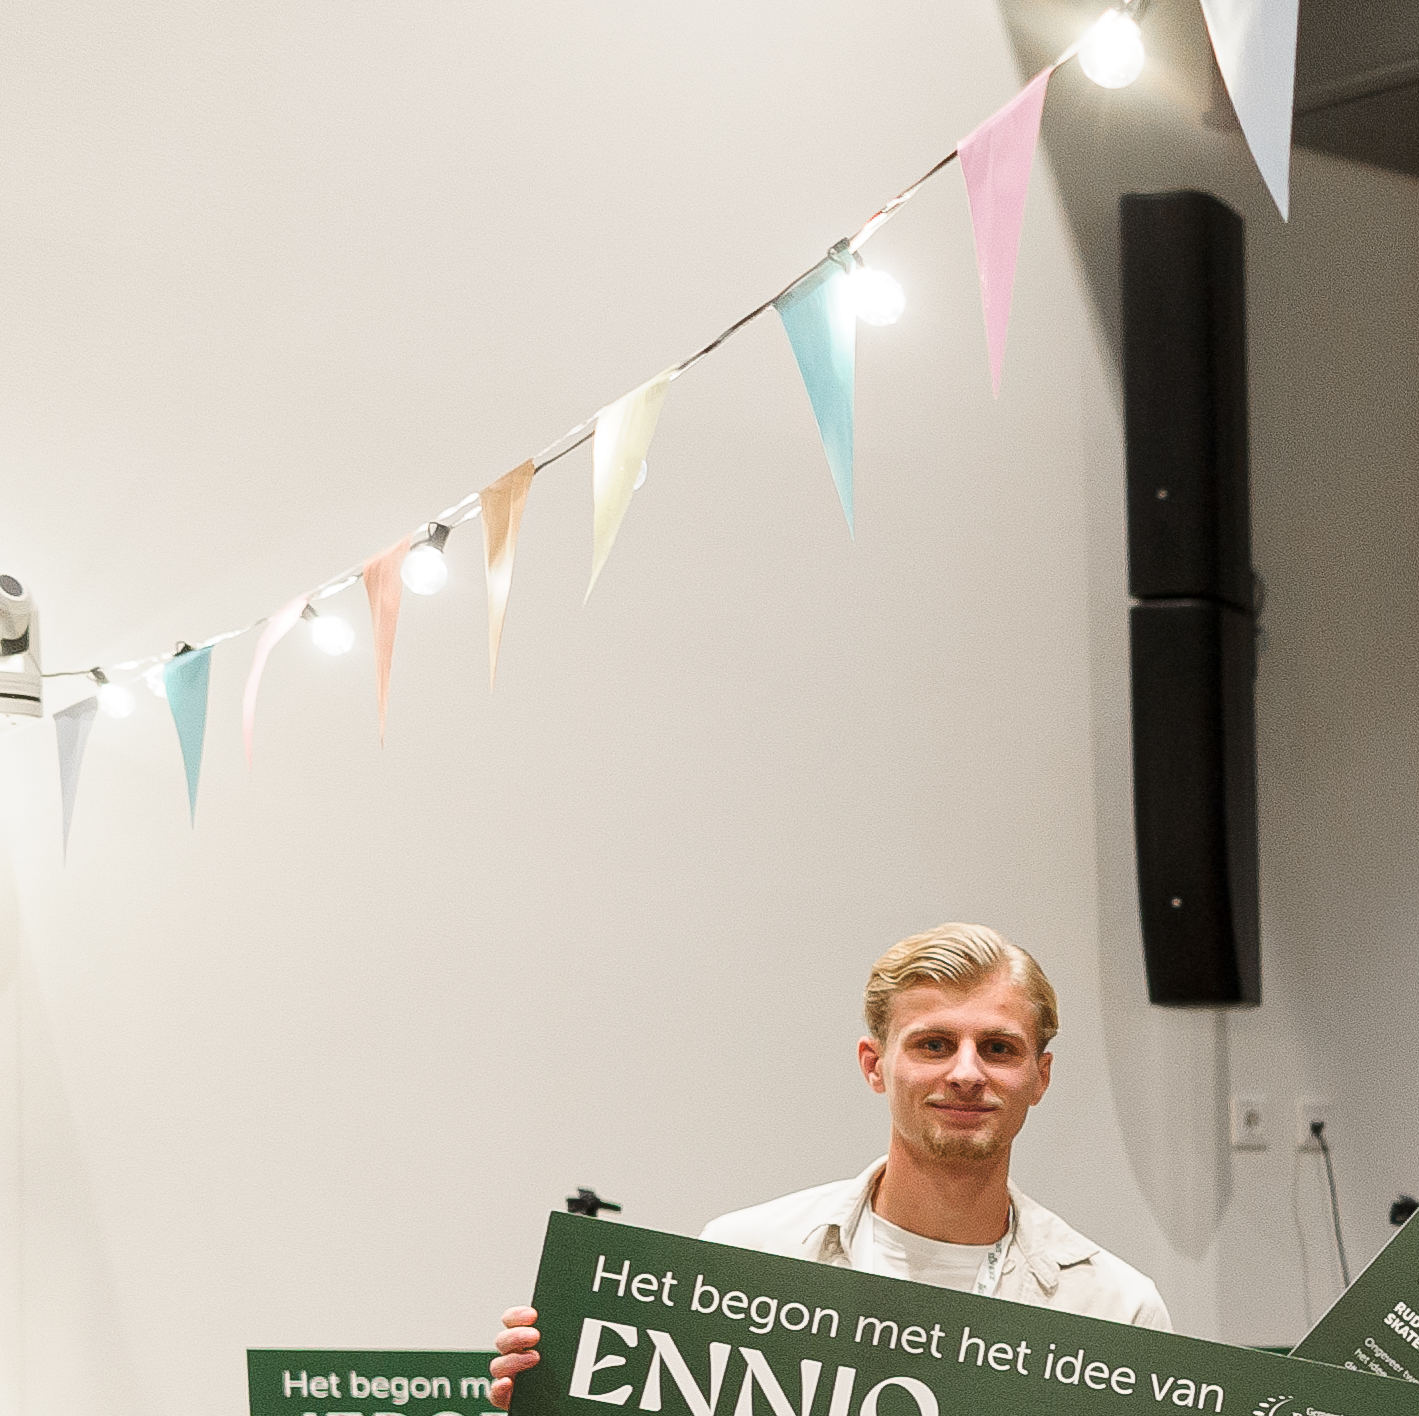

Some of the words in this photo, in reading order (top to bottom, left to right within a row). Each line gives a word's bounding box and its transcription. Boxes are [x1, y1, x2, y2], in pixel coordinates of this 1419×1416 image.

[592, 1255, 678, 1307] Het
[690, 1274, 839, 1338] begon
[854, 1316, 946, 1359] met
[958, 1326, 1032, 1376] het
[1044, 1343, 1136, 1395] idee
[1151, 1373, 1224, 1413] van
[1364, 1337, 1405, 1373] Ongeveer
[282, 1370, 342, 1399] Het
[349, 1370, 452, 1406] begon
